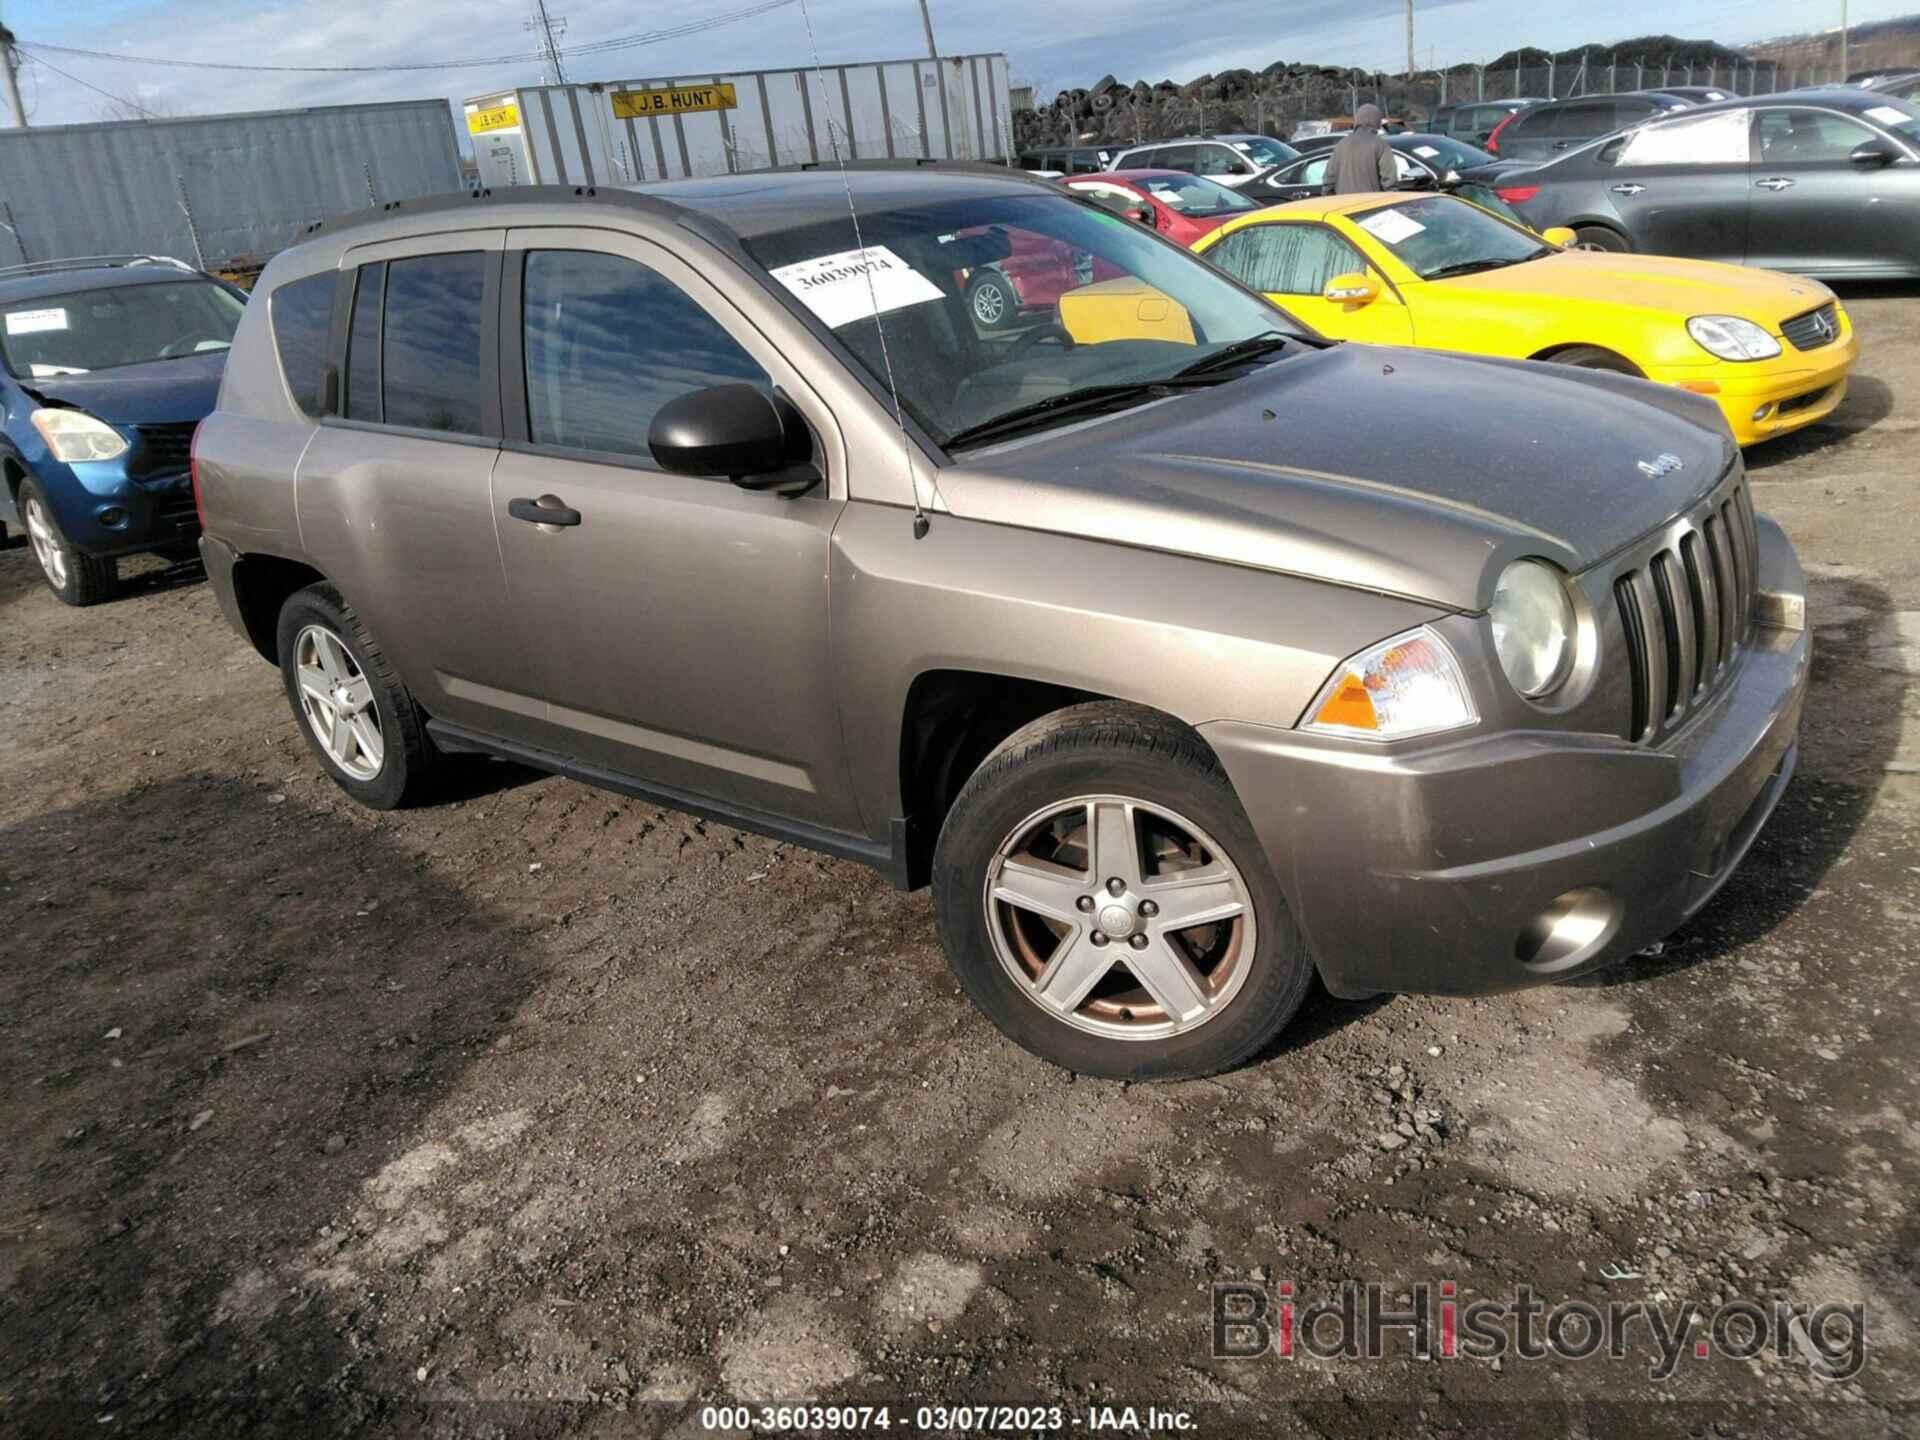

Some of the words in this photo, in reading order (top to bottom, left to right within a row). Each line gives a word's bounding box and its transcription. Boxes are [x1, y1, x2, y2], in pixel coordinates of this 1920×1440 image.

[639, 96, 668, 112] J.B.
[671, 91, 714, 107] HUNT
[797, 258, 893, 291] 36039074
